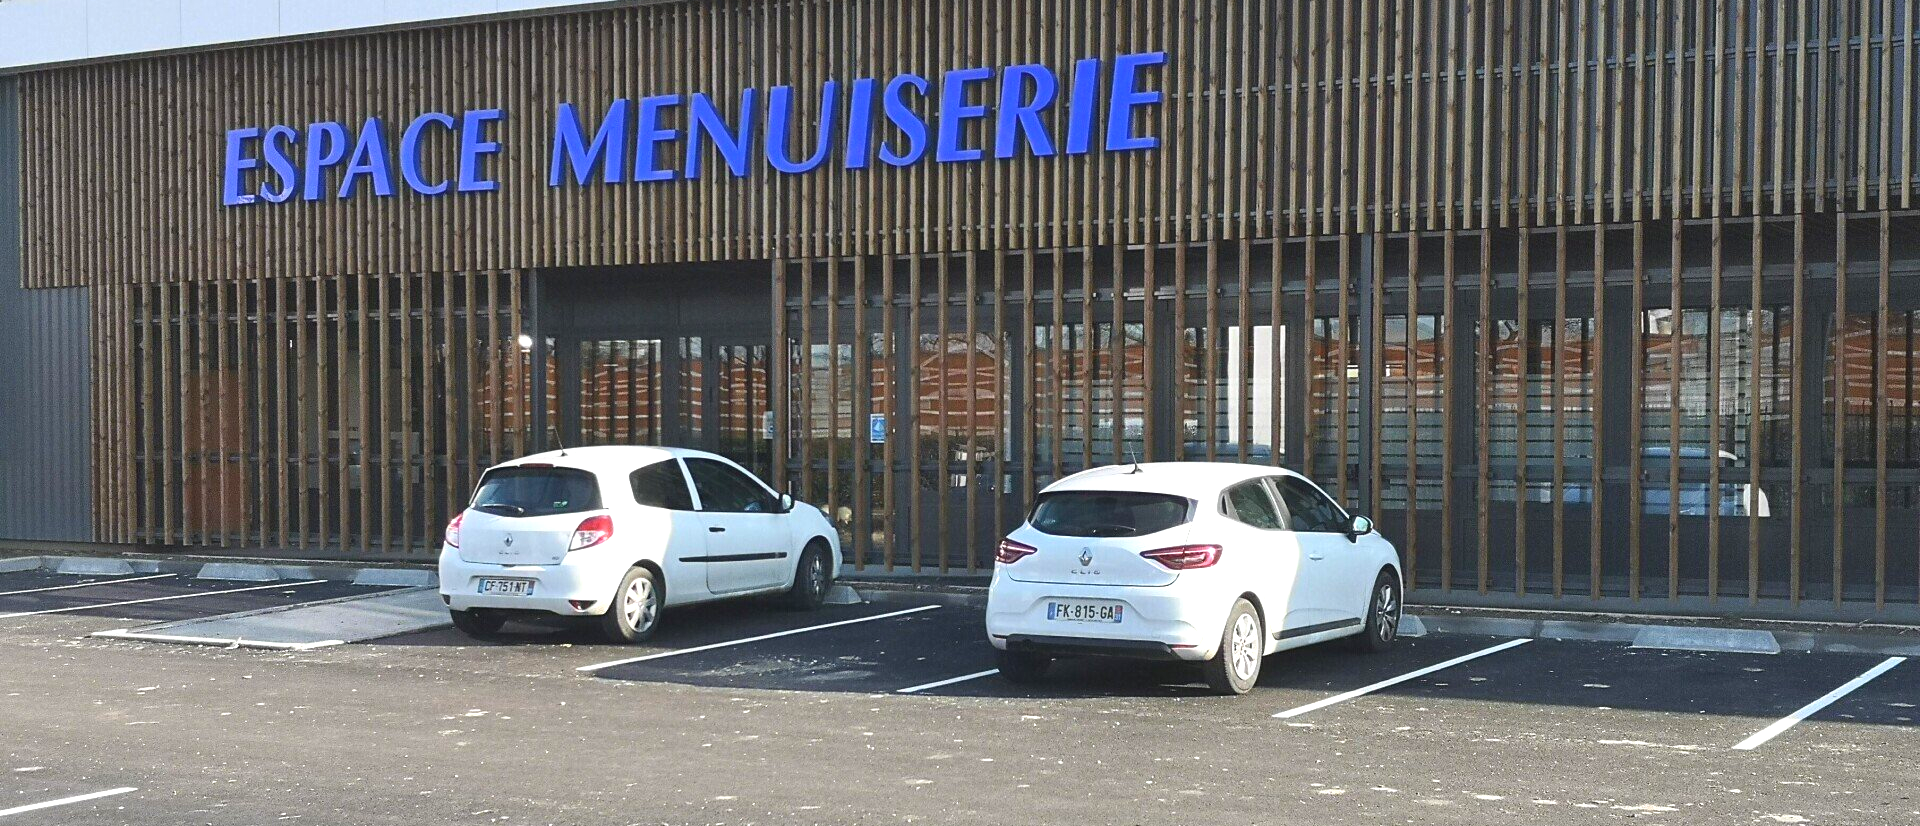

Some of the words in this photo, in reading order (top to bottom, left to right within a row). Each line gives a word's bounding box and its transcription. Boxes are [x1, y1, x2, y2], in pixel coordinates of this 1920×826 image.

[223, 109, 503, 206] ESPACE
[549, 51, 1167, 188] MENUISERIE
[1056, 604, 1114, 619] FK-815-GA
